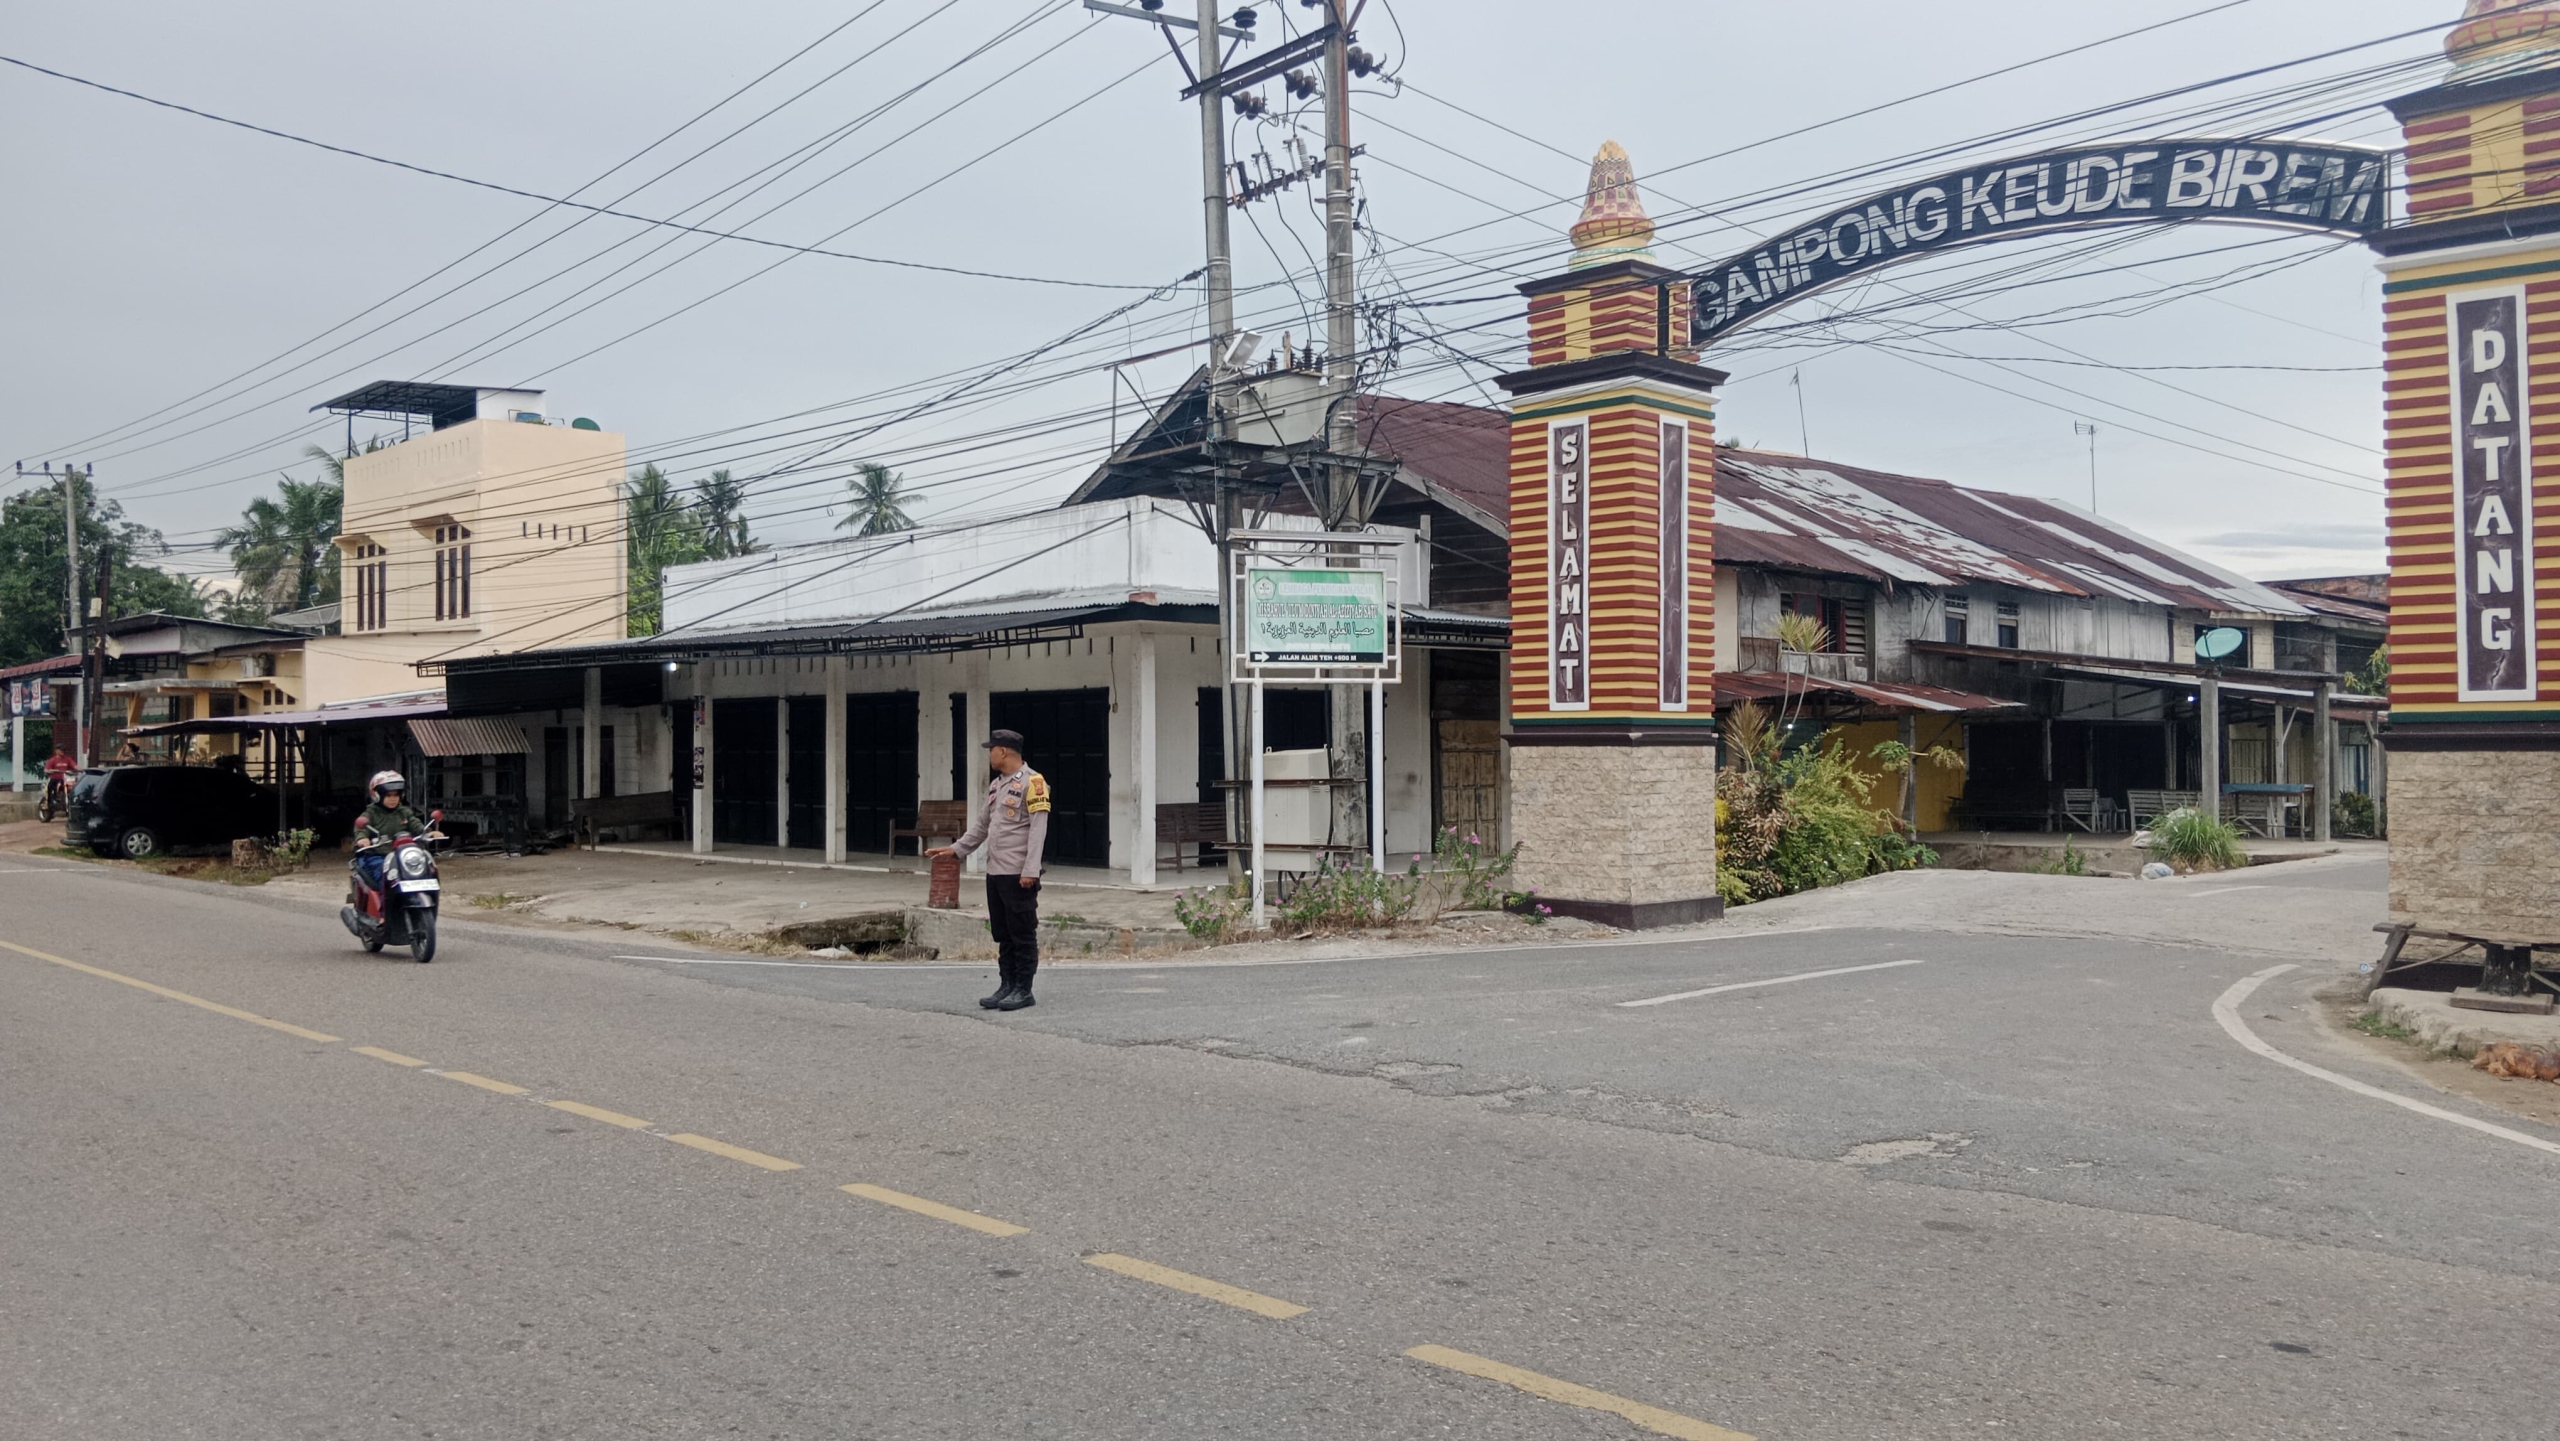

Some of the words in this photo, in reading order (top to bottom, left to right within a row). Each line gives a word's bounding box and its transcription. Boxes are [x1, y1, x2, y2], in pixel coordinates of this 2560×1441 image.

[1690, 186, 1948, 331] GAMPONG
[1961, 151, 2159, 232] KEUDE
[2166, 148, 2380, 224] BIREM
[1559, 431, 1581, 690] SELAMAT
[2471, 329, 2514, 651] DATANG
